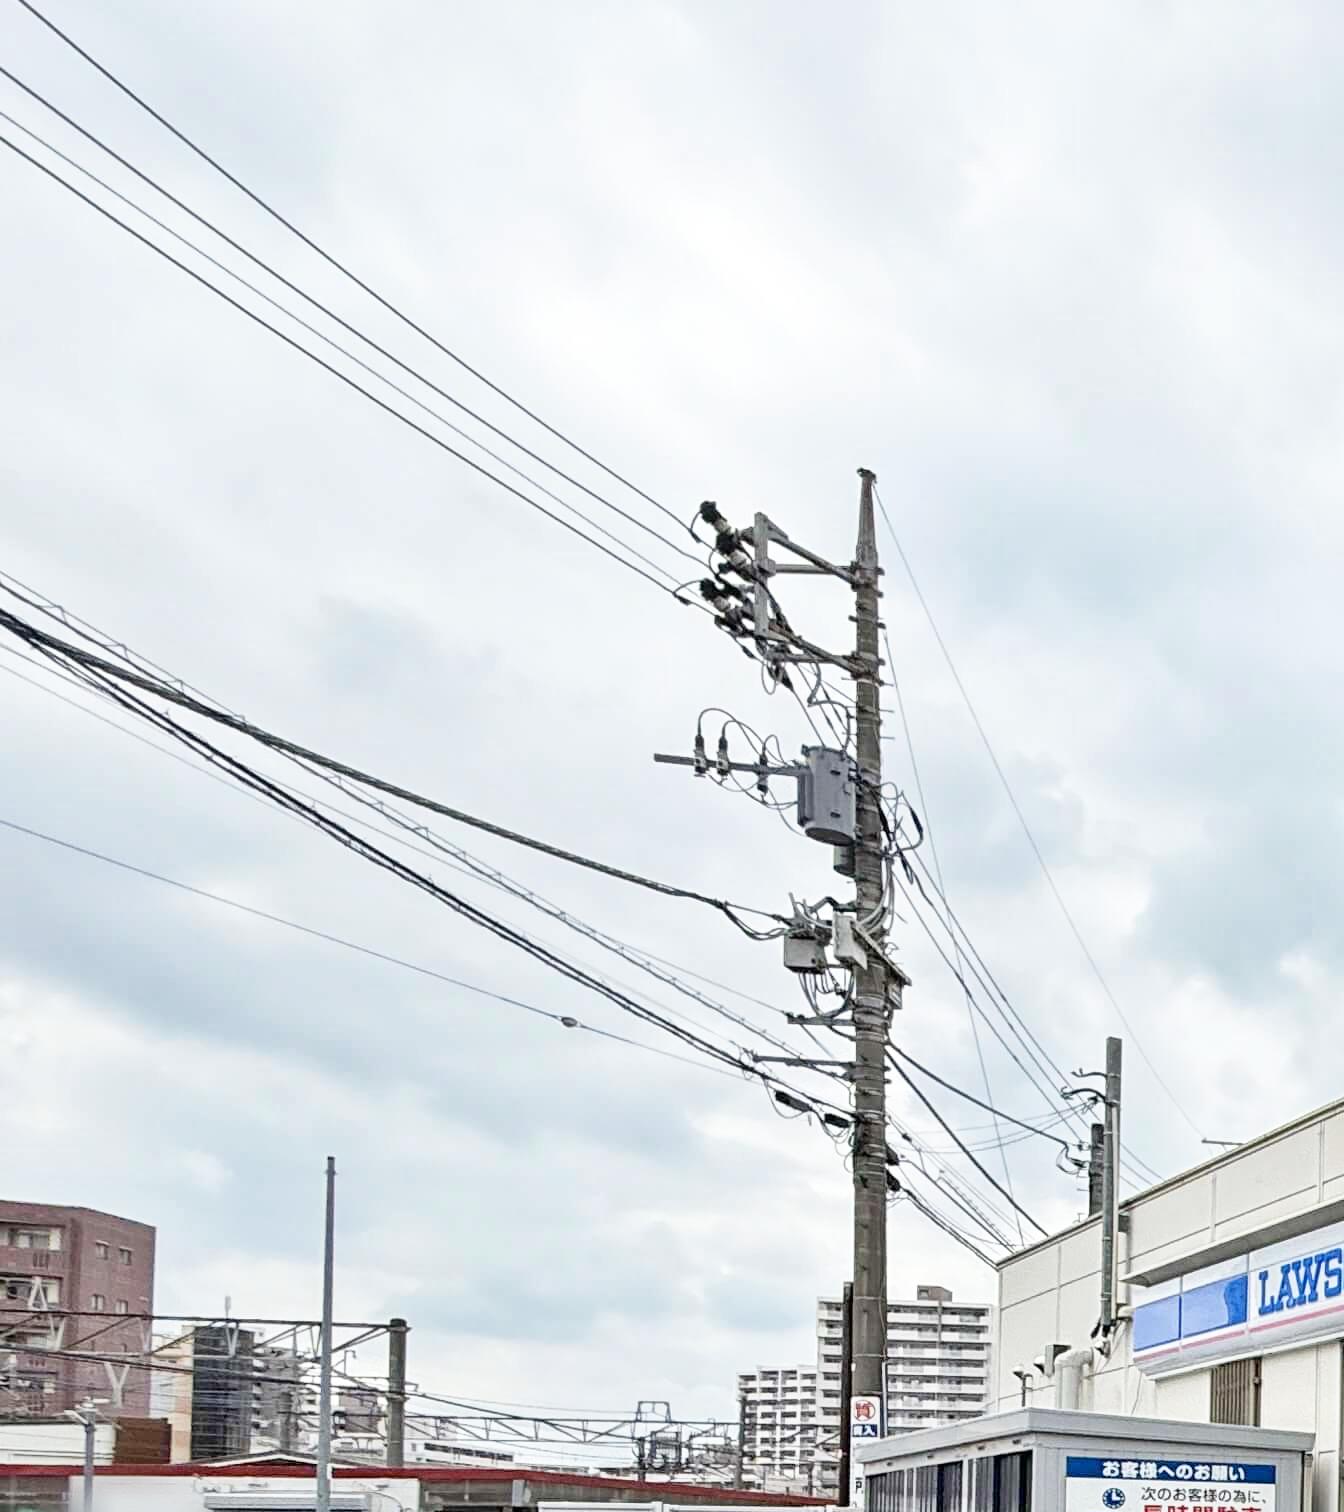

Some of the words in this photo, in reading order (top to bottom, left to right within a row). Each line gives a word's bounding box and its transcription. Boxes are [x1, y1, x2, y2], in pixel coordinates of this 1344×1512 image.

[1102, 1461, 1246, 1480] お客様へのお願い
[1141, 1487, 1267, 1504] 次のお客様の為に、
